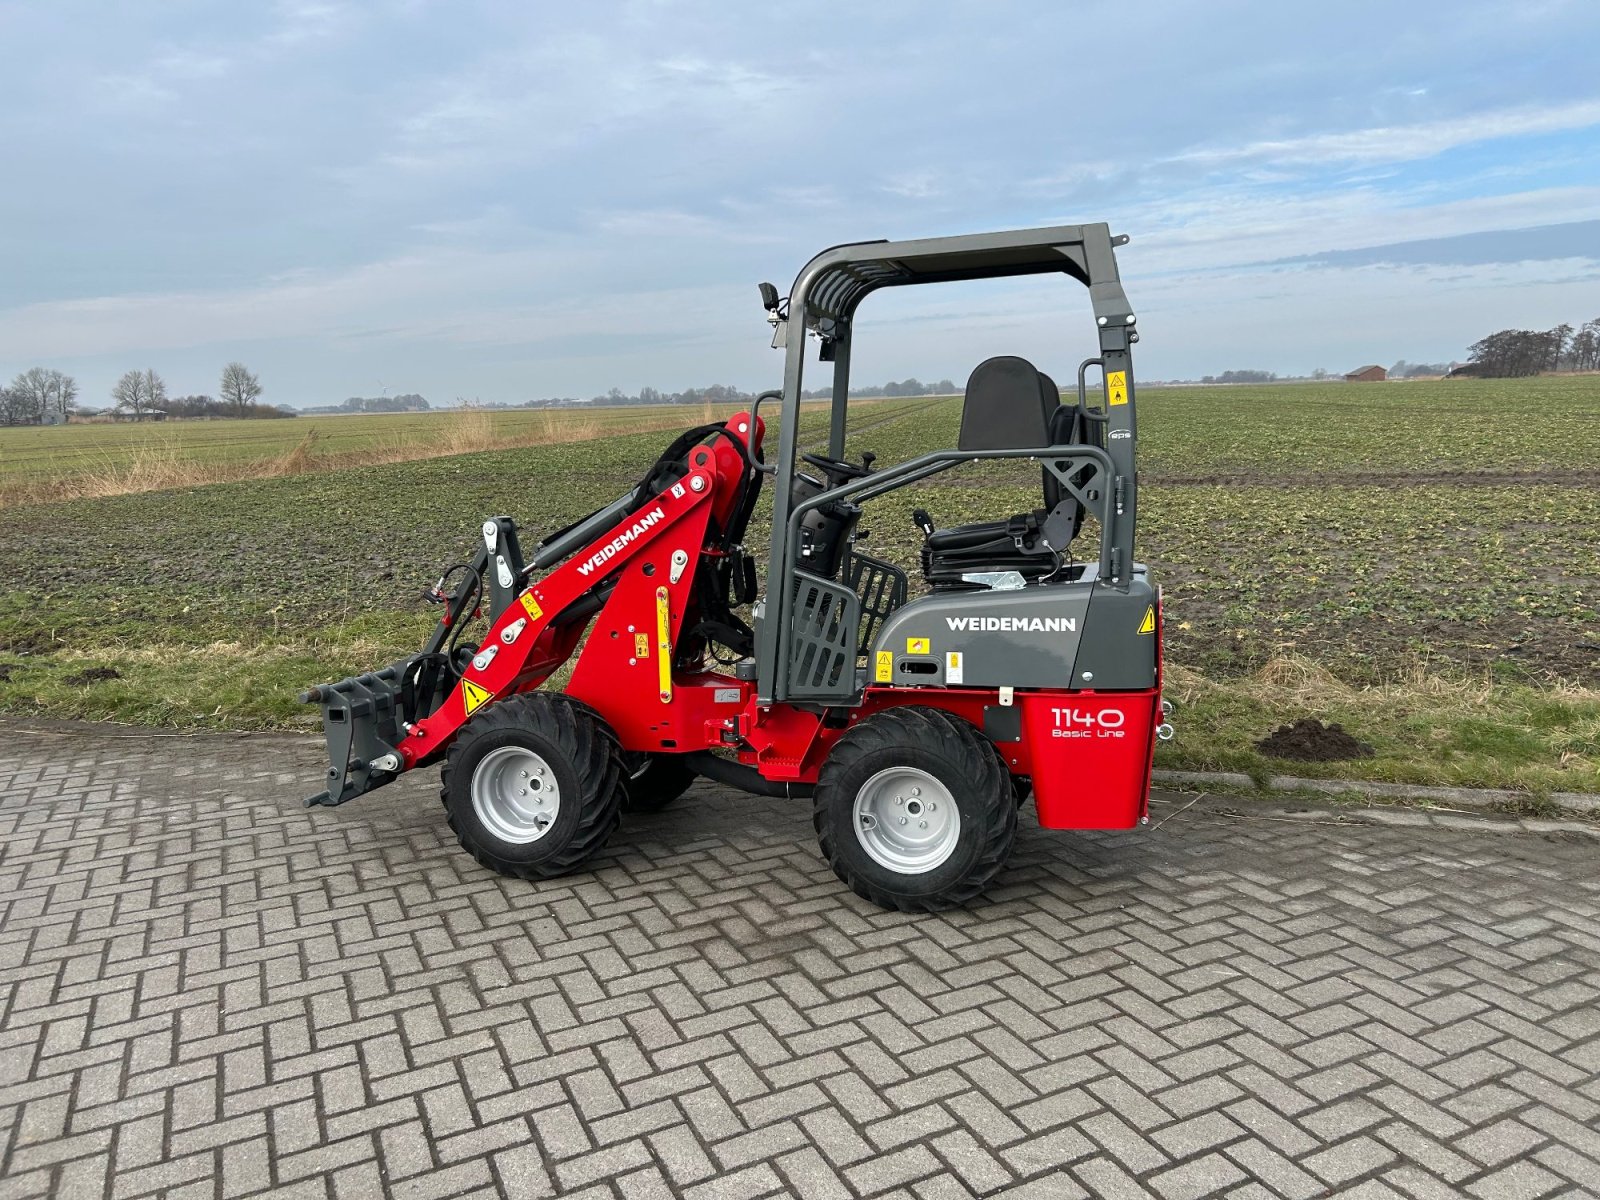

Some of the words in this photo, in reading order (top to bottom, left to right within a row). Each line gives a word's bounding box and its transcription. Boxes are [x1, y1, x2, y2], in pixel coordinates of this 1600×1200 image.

[577, 507, 666, 576] WEIDEMANN
[946, 617, 1076, 632] WEIDEMANN
[1051, 708, 1125, 728] 1140
[1052, 729, 1092, 738] Basic
[1097, 729, 1125, 738] Line
